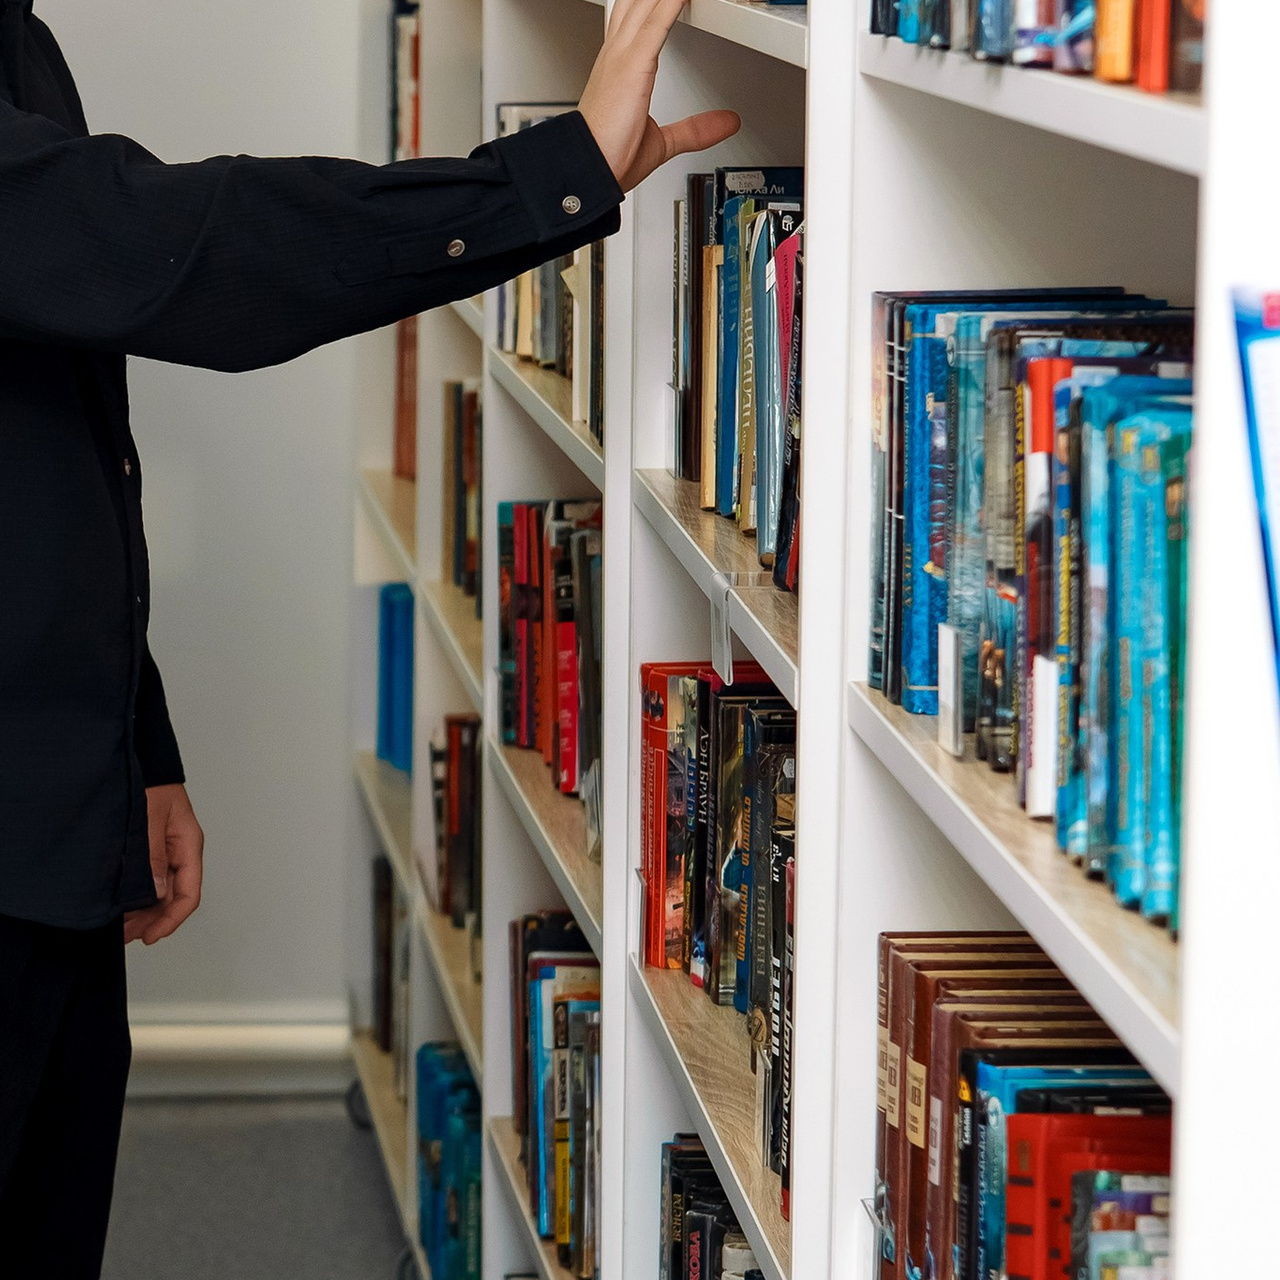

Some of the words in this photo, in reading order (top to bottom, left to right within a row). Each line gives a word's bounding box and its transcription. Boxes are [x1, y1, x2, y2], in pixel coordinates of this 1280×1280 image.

[769, 184, 784, 194] Ли
[699, 726, 709, 768] ДЭН
[698, 770, 708, 823] БРАУН
